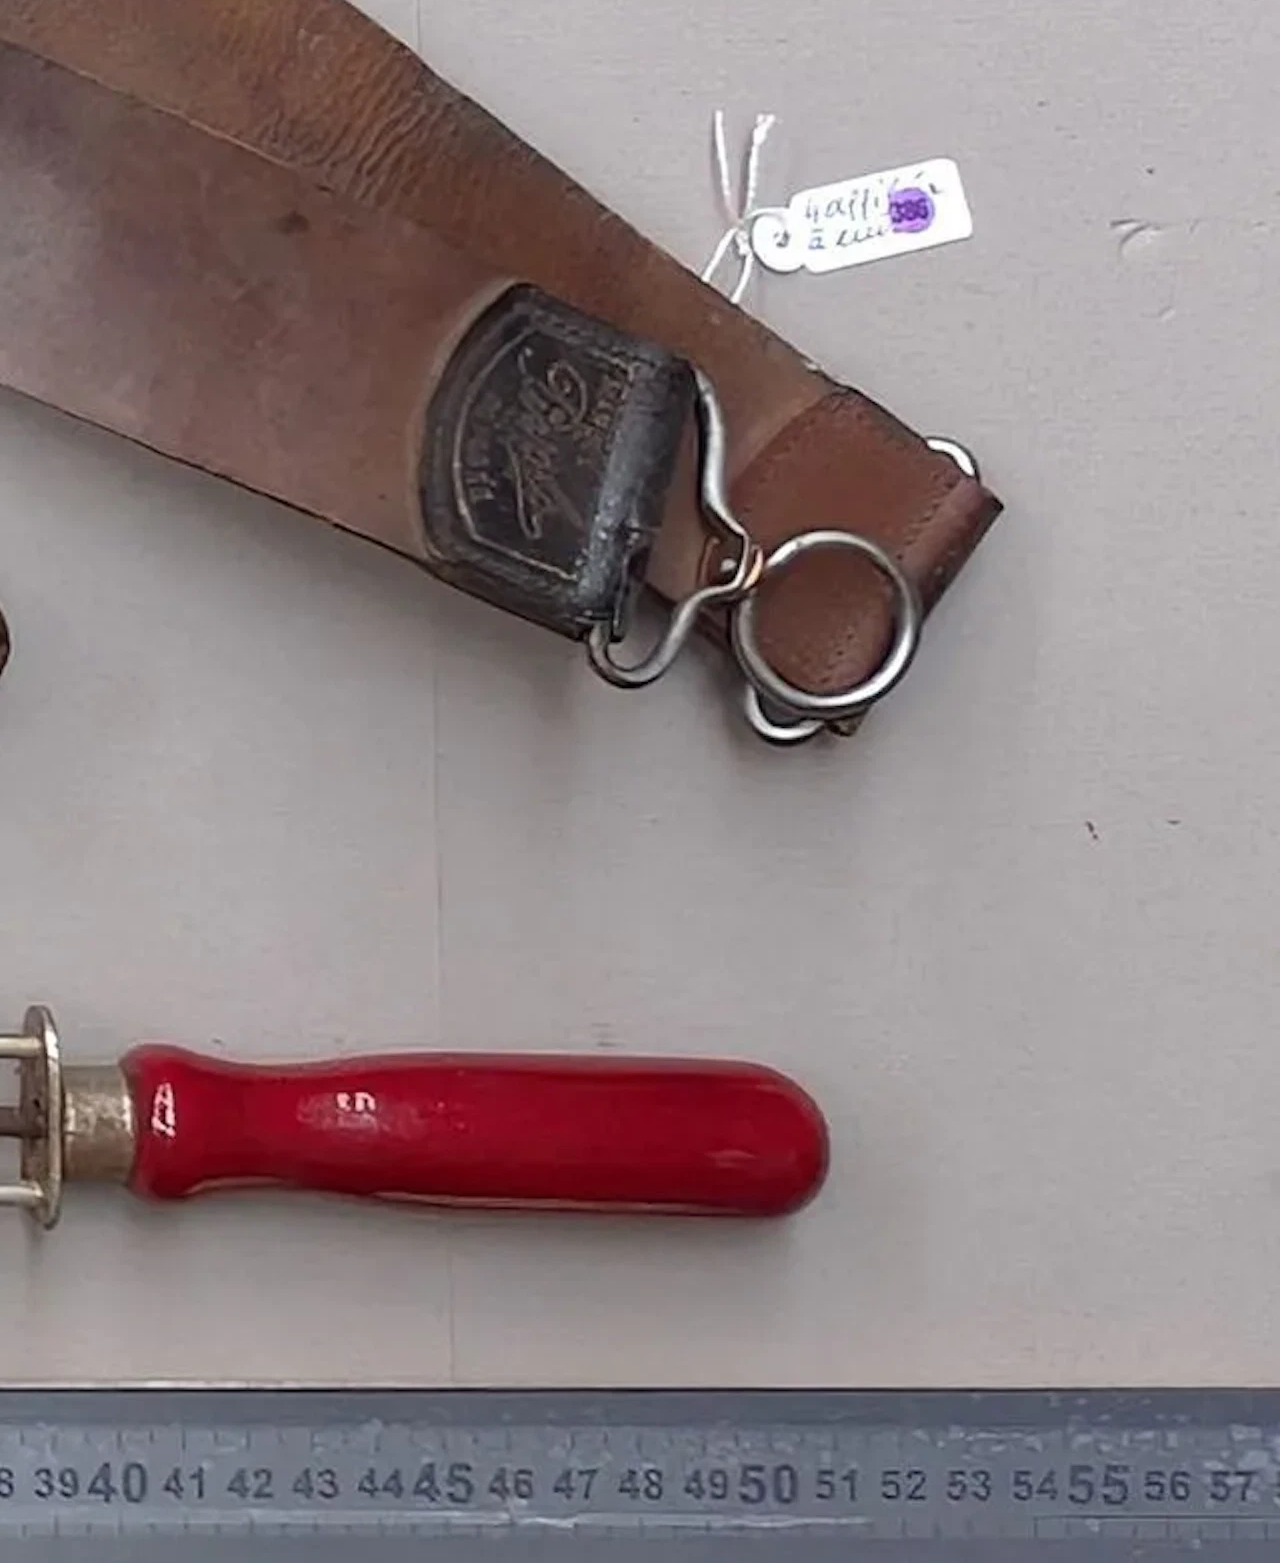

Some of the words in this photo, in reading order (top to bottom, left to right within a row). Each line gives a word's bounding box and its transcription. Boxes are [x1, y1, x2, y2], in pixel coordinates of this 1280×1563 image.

[34, 1467, 79, 1498] 39
[87, 1461, 147, 1504] 40
[162, 1466, 204, 1499] 41
[226, 1468, 273, 1499] 42
[292, 1467, 340, 1499] 43
[357, 1467, 404, 1498] 44
[412, 1462, 474, 1504] 45
[487, 1467, 533, 1500] 46
[552, 1468, 598, 1500] 47
[618, 1468, 662, 1500] 48
[683, 1468, 728, 1500] 49
[737, 1463, 797, 1505] 50
[815, 1468, 857, 1501] 51
[881, 1469, 926, 1500] 52
[946, 1469, 992, 1501] 53
[1013, 1469, 1058, 1501] 54
[1067, 1463, 1129, 1505] 55
[1144, 1470, 1191, 1501] 56
[1207, 1468, 1257, 1502] 57
